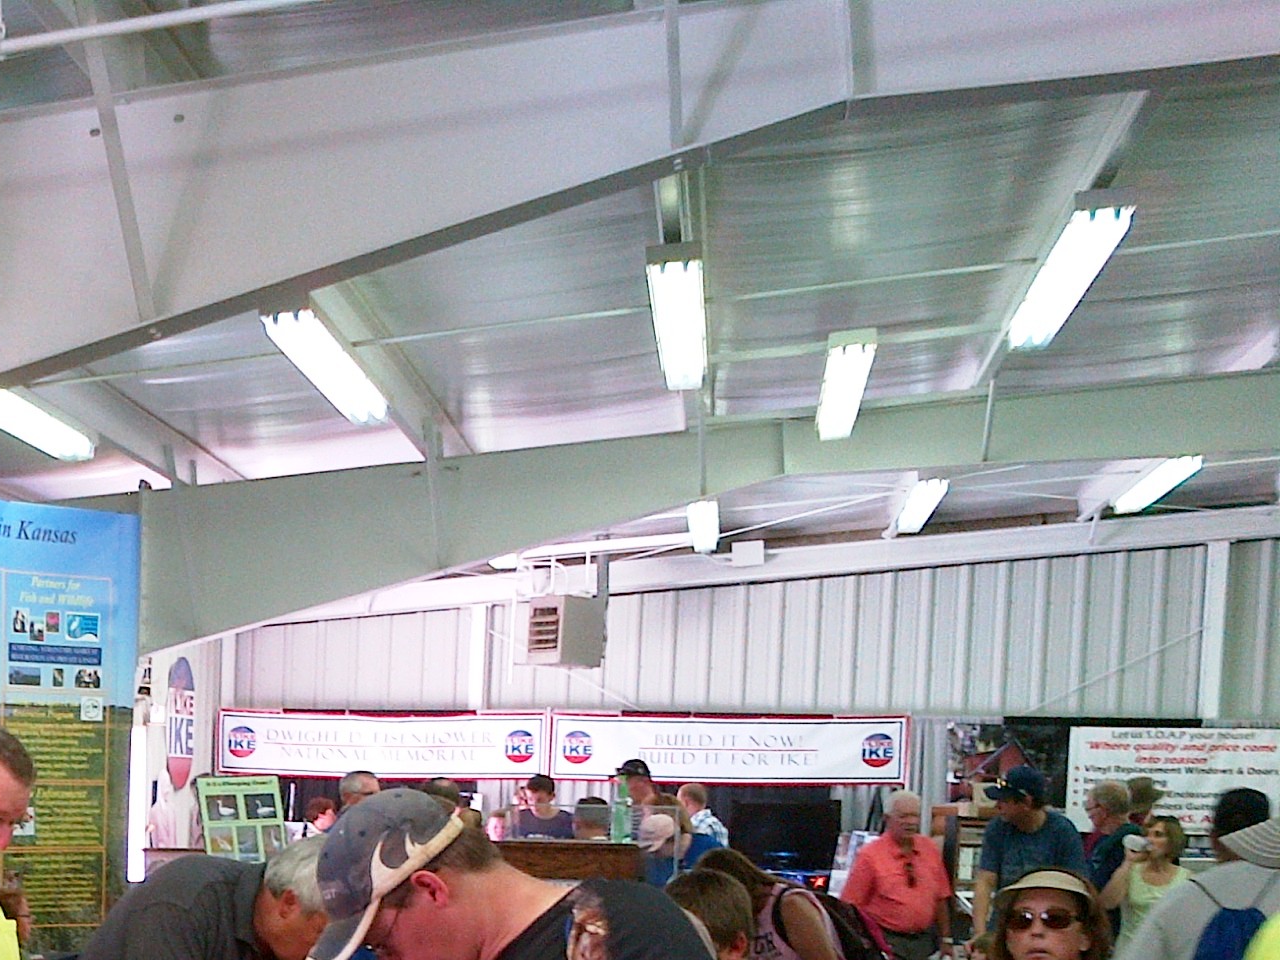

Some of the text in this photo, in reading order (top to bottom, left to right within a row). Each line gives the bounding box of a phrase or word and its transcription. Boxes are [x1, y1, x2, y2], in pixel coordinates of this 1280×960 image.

[16, 519, 78, 546] Kansas
[168, 716, 194, 755] IKE
[266, 729, 341, 743] DWIGHT
[654, 734, 714, 747] BUILD
[721, 735, 739, 748] IT
[1189, 733, 1214, 742] your
[228, 738, 257, 750] IKE
[505, 744, 535, 755] IKE
[1133, 743, 1176, 754] quality
[1181, 744, 1206, 752] and
[1207, 744, 1240, 754] price
[1242, 744, 1277, 753] come
[280, 746, 479, 762] NATIONAL MEMORIAL
[562, 745, 593, 756] IKE
[861, 747, 894, 760] IKE
[638, 751, 697, 765] BUILD
[705, 752, 720, 765] IT
[730, 753, 769, 766] FOR
[1135, 756, 1161, 764] into
[1084, 765, 1112, 774] Vinyl
[1114, 765, 1182, 775] Replacement
[1184, 766, 1234, 775] Windows
[1247, 767, 1279, 775] Doors
